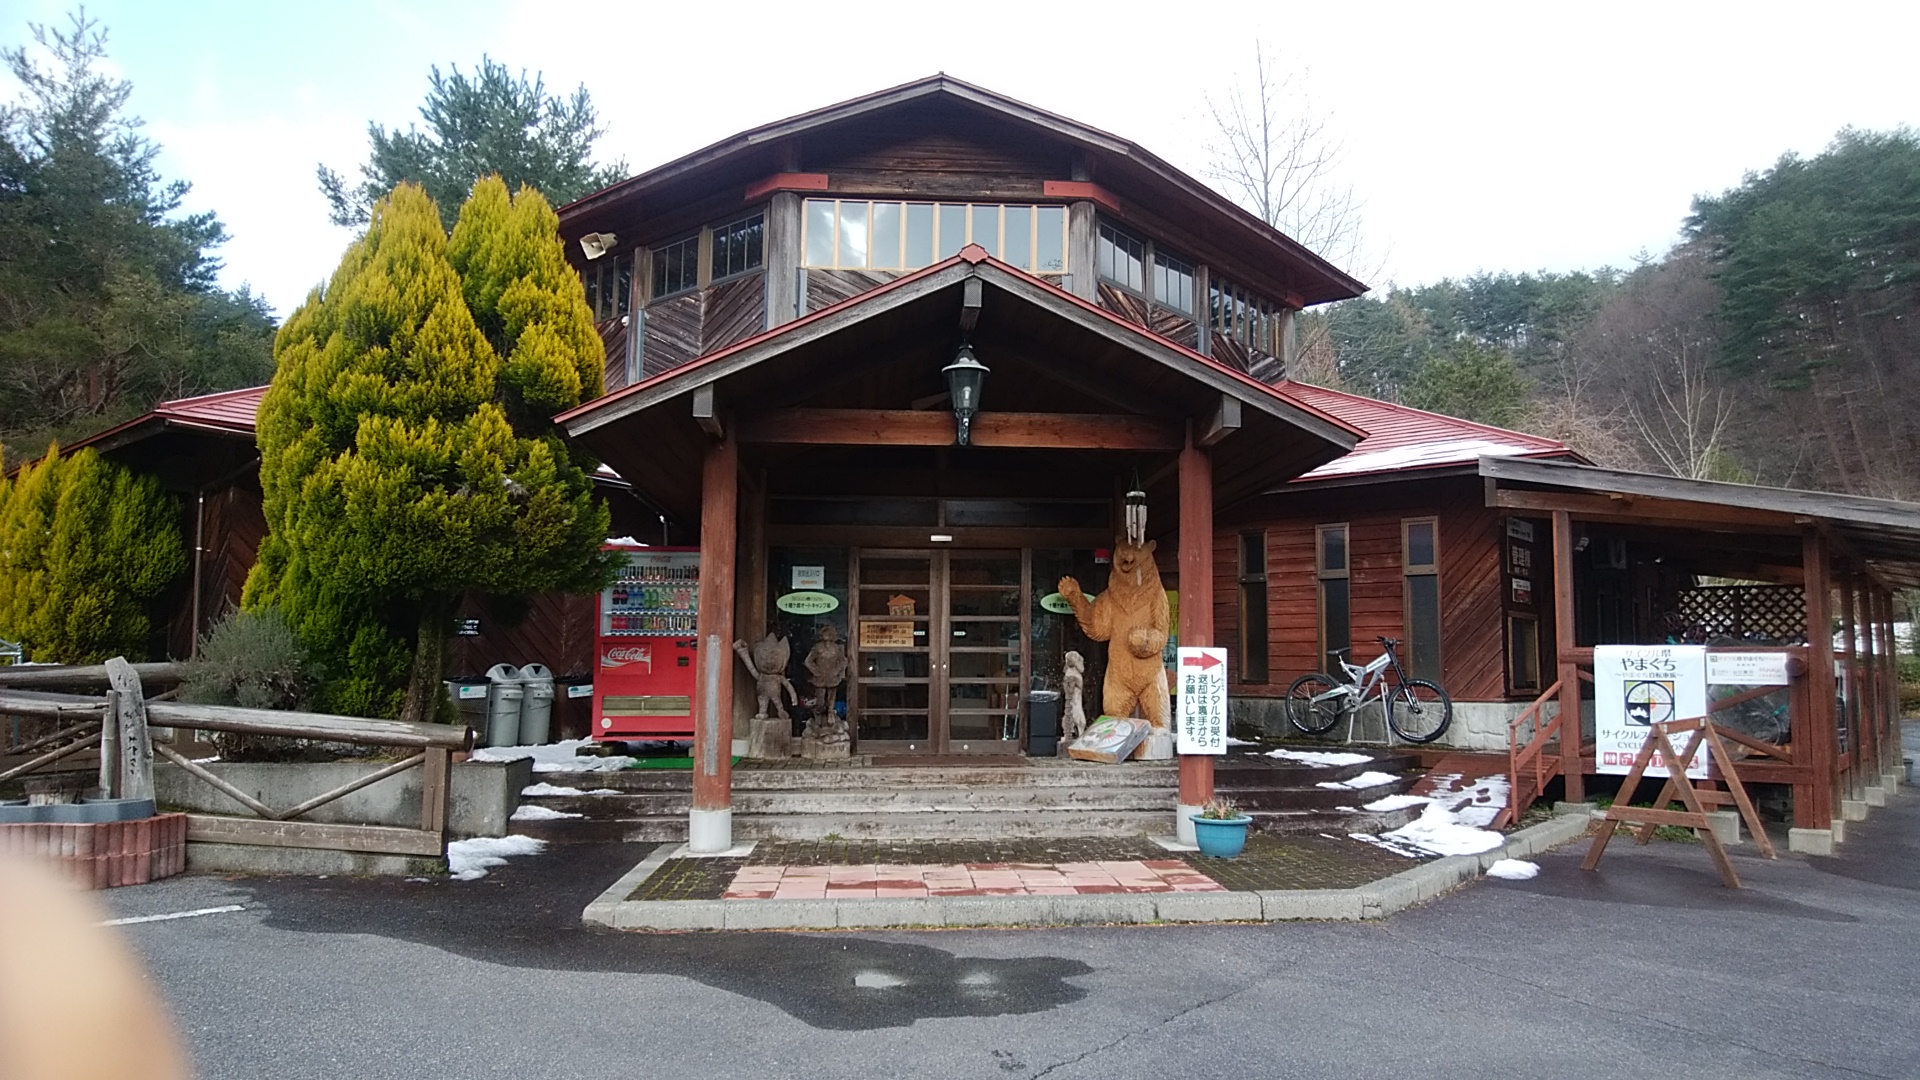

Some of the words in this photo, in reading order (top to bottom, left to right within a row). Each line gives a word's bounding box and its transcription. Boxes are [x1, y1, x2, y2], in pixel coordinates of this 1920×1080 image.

[1621, 658, 1677, 671] やまぐち
[1626, 649, 1671, 658] サイクル県
[1185, 674, 1196, 742] お願いします。
[1198, 674, 1208, 748] 返却は裏手から
[1211, 674, 1221, 748] レンタルの受付
